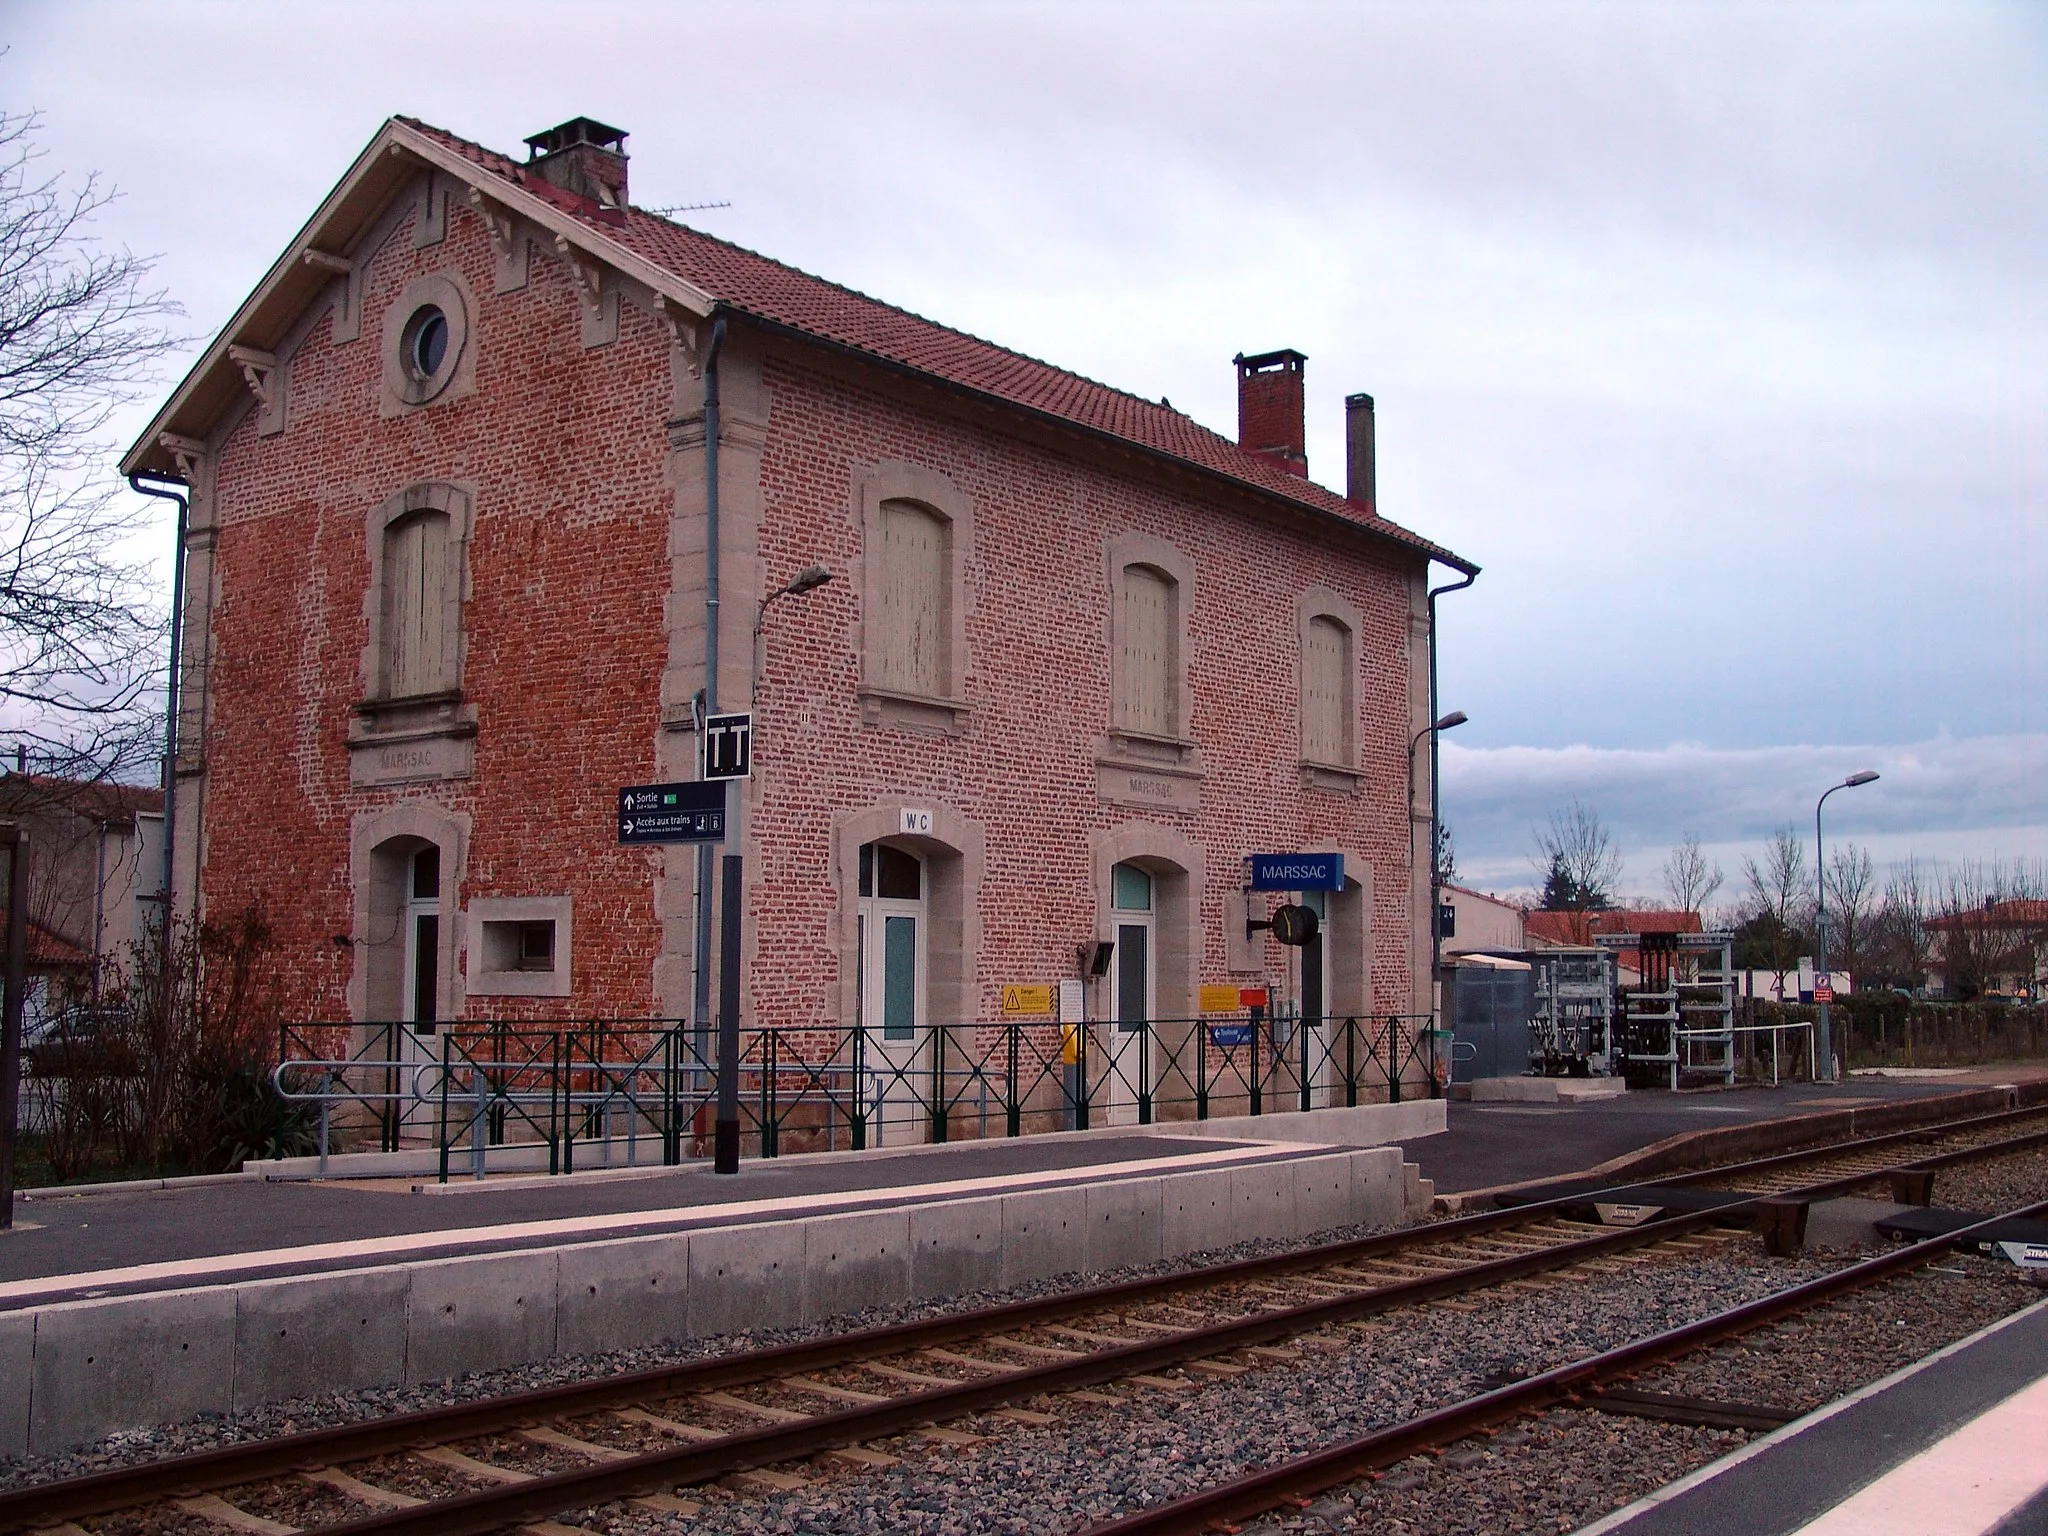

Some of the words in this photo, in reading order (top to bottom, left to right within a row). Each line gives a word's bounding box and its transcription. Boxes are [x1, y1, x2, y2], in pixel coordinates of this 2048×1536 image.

[1129, 778, 1172, 798] MARSSAC
[636, 792, 658, 803] Sortie
[636, 816, 656, 828] Accès
[656, 817, 670, 826] aux
[670, 814, 691, 825] trains
[1262, 865, 1326, 879] MARSSAC
